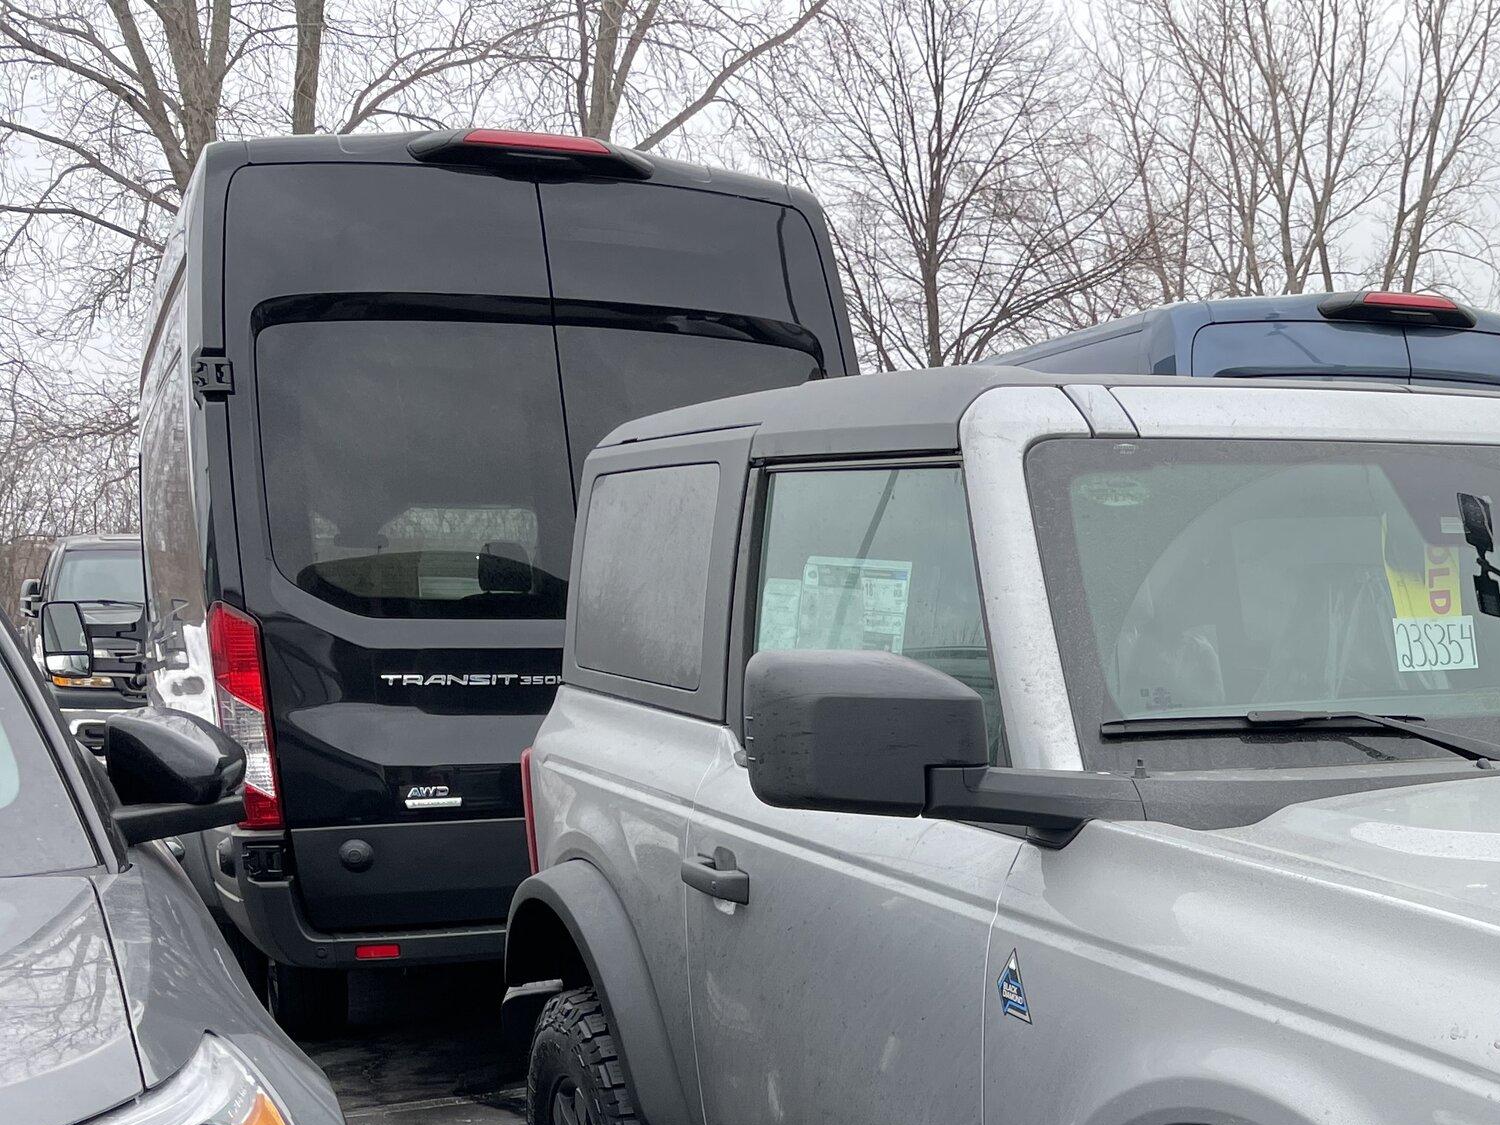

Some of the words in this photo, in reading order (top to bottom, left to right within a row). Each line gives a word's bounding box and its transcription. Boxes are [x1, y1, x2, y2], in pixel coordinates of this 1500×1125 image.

[1427, 546, 1451, 615] OLD
[380, 674, 519, 687] TRANSIT
[407, 786, 450, 798] AWD
